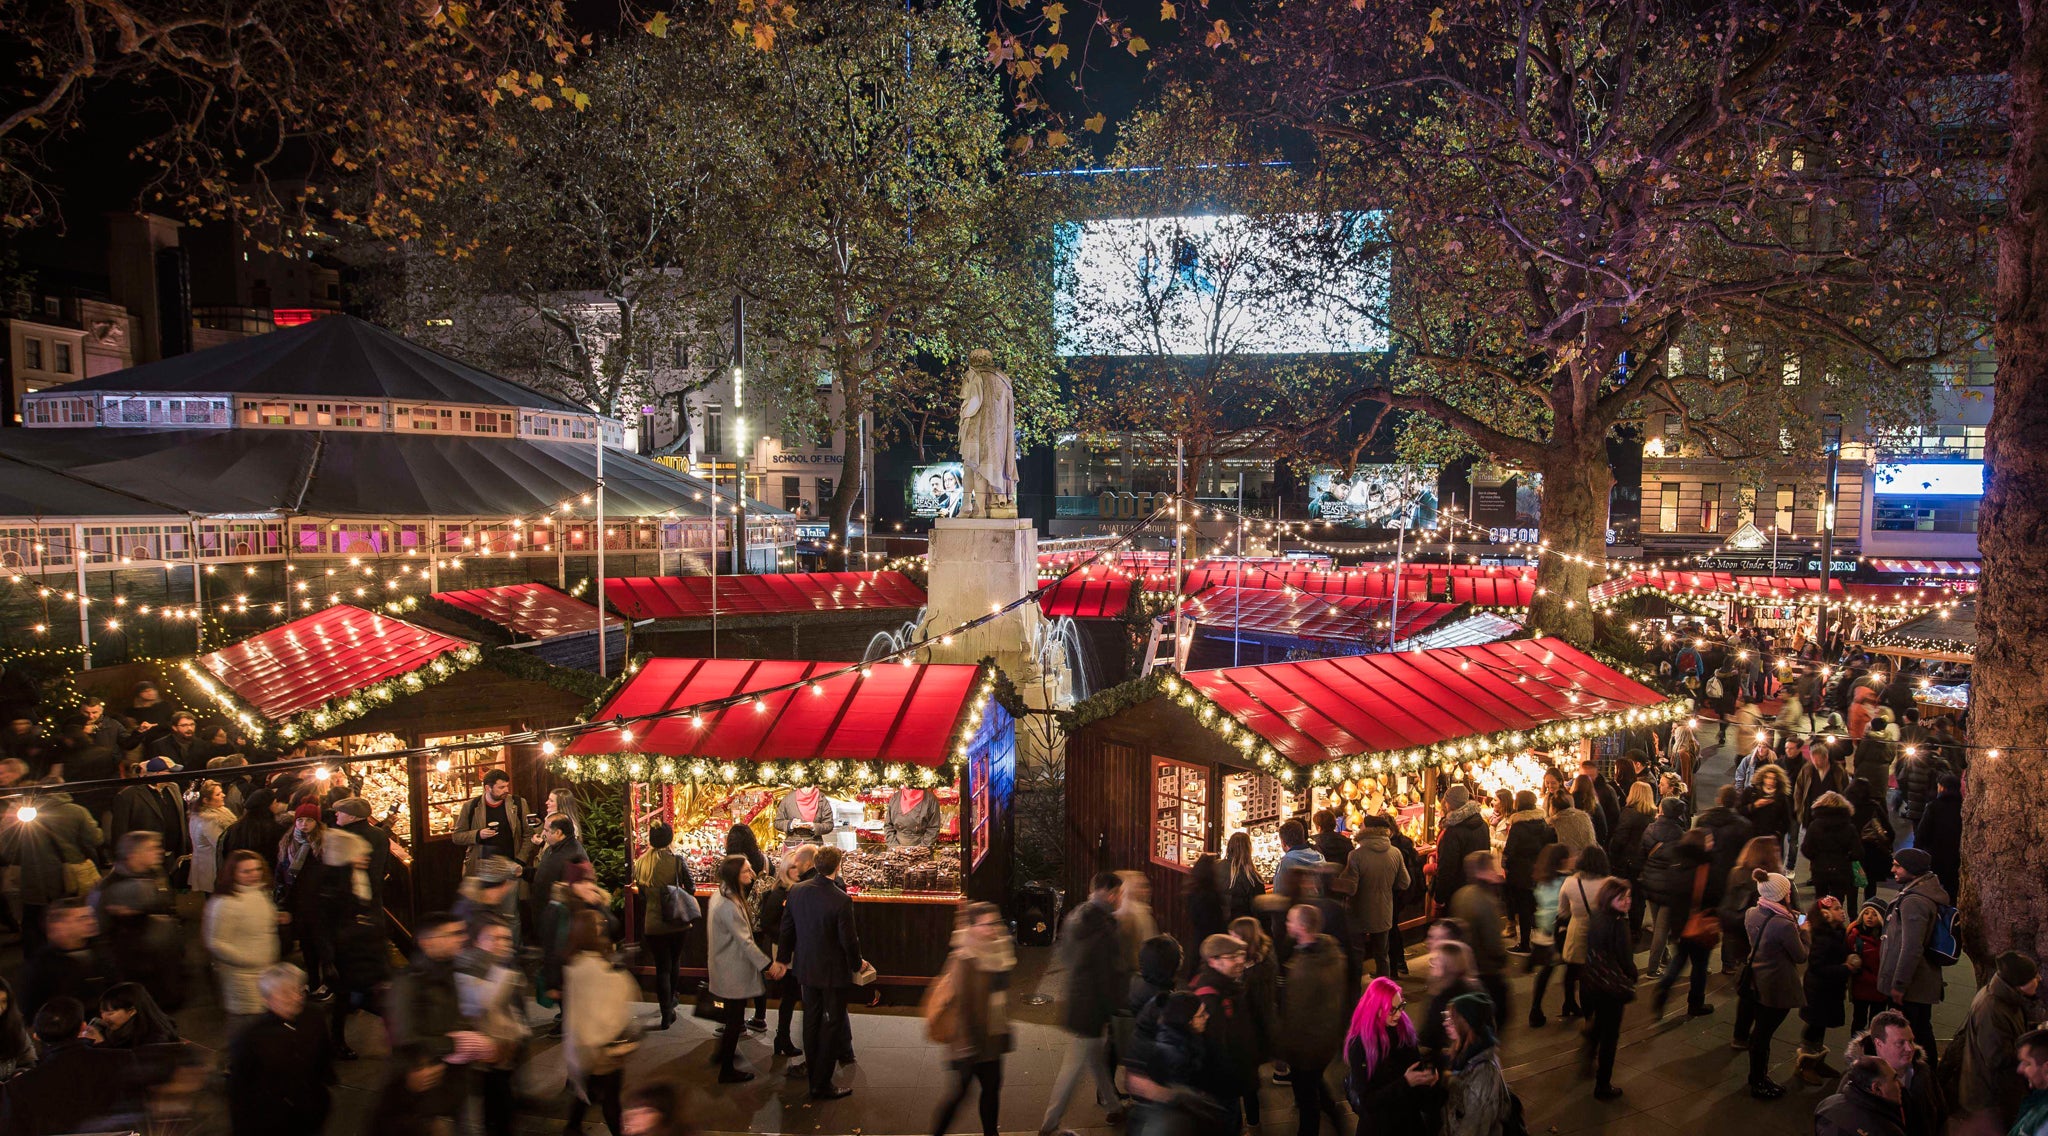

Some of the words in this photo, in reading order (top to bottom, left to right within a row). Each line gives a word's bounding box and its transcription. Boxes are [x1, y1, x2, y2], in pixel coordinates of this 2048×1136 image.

[773, 455, 808, 463] SCHOOL
[810, 455, 823, 463] OF
[824, 455, 845, 464] ENG
[1099, 491, 1170, 519] ODEO
[1320, 505, 1349, 514] BEASTS
[1489, 528, 1538, 543] ODEON
[1699, 557, 1715, 569] The
[1717, 559, 1738, 569] Moon
[1741, 557, 1765, 570] Under
